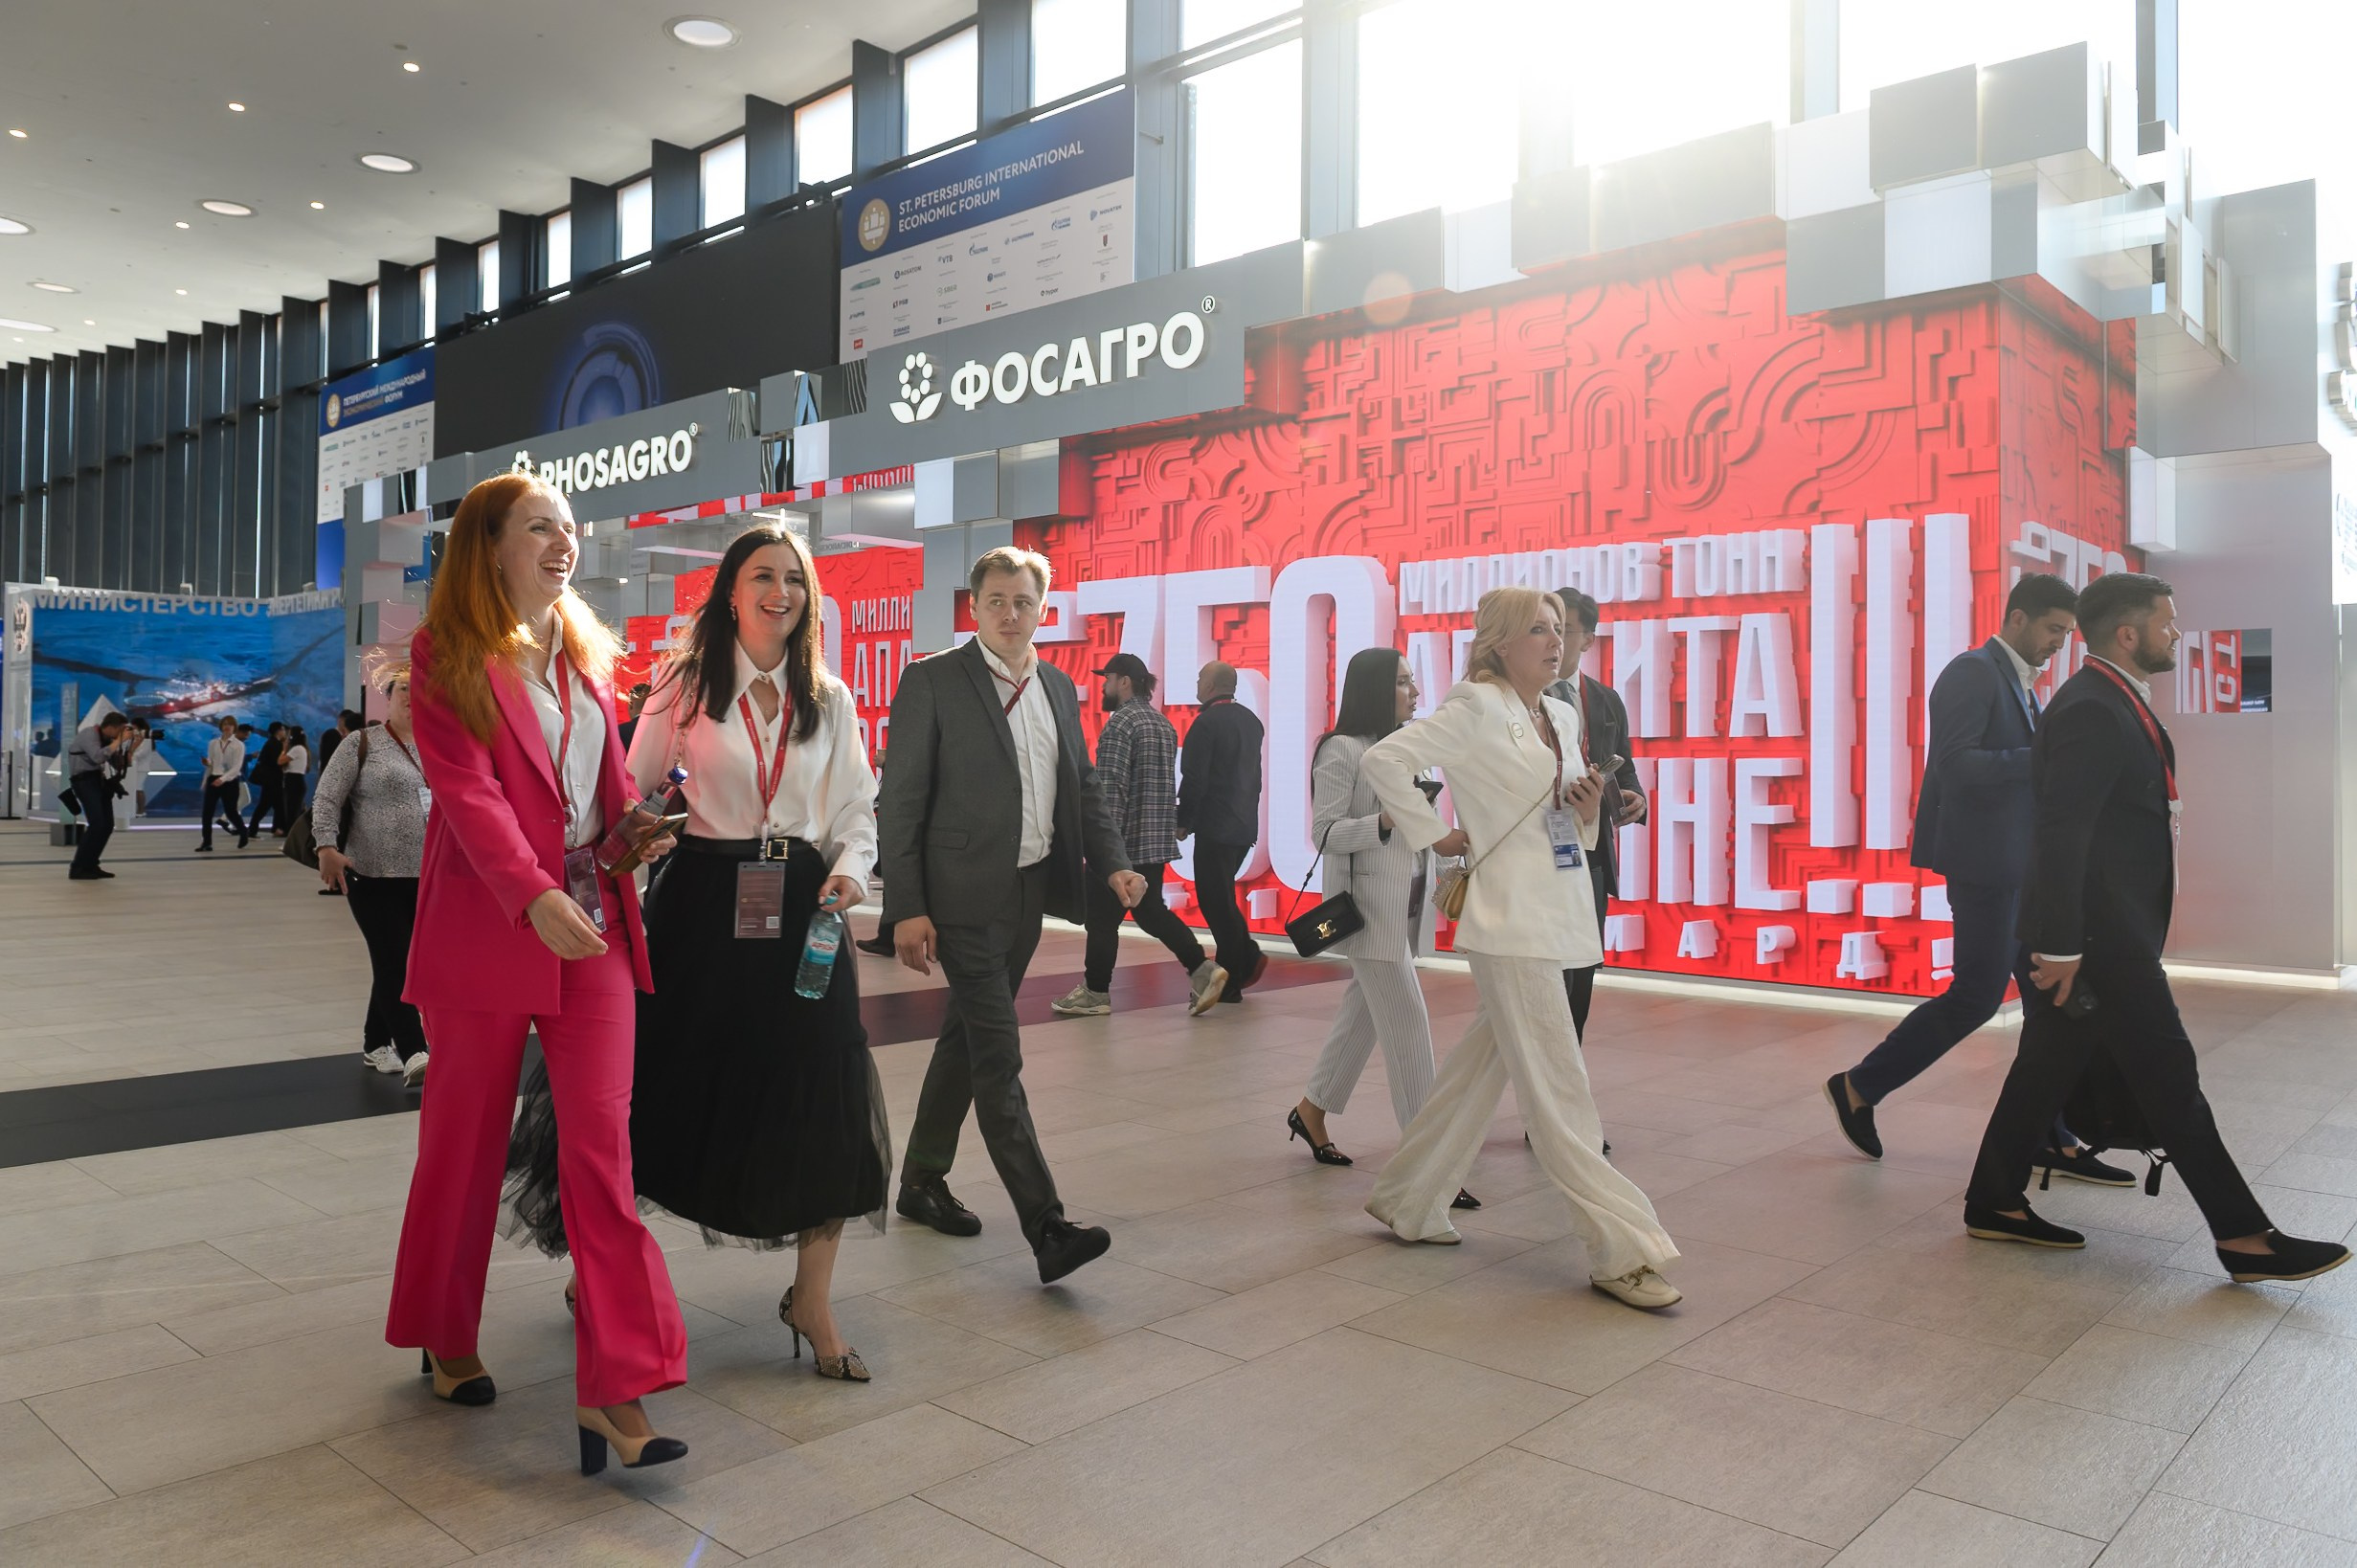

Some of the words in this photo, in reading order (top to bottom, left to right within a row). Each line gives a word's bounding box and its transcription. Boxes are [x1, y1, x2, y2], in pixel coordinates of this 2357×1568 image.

[898, 201, 957, 233] ECONOMIC
[958, 187, 1000, 213] FORUM
[899, 199, 912, 215] ST.
[914, 174, 983, 210] PETERSBURG
[985, 140, 1084, 186] INTERNATIONAL
[950, 310, 1204, 412] ФОСАГРО
[540, 429, 692, 493] PHOSAGRO
[1663, 529, 1806, 597] ТОНН
[34, 591, 260, 618] МИНИСТЕРСТВО
[1407, 613, 1806, 737] АИТА
